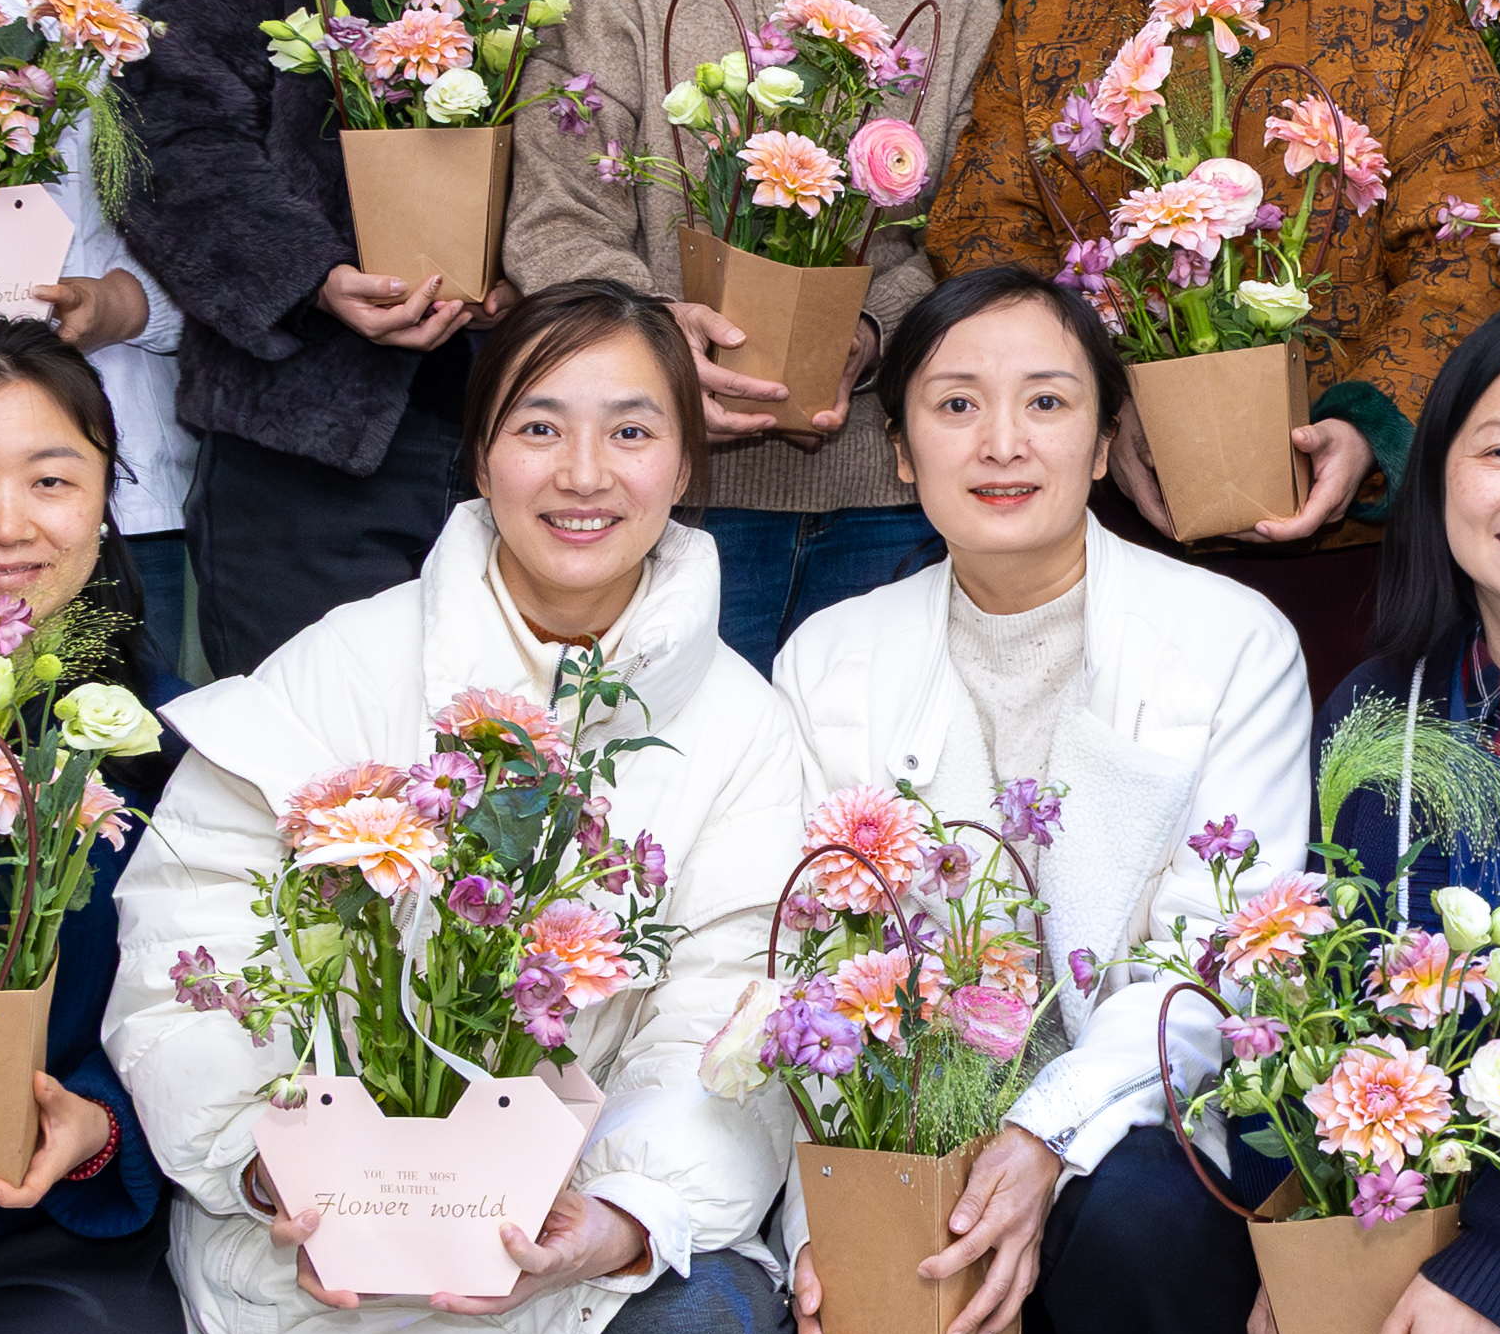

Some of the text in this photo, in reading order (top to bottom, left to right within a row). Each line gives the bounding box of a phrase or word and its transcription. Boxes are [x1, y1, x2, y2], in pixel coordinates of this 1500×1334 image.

[363, 1170, 458, 1182] YOU THE MOST
[380, 1184, 439, 1195] BEAUTIFUL
[314, 1192, 507, 1218] Flower world
